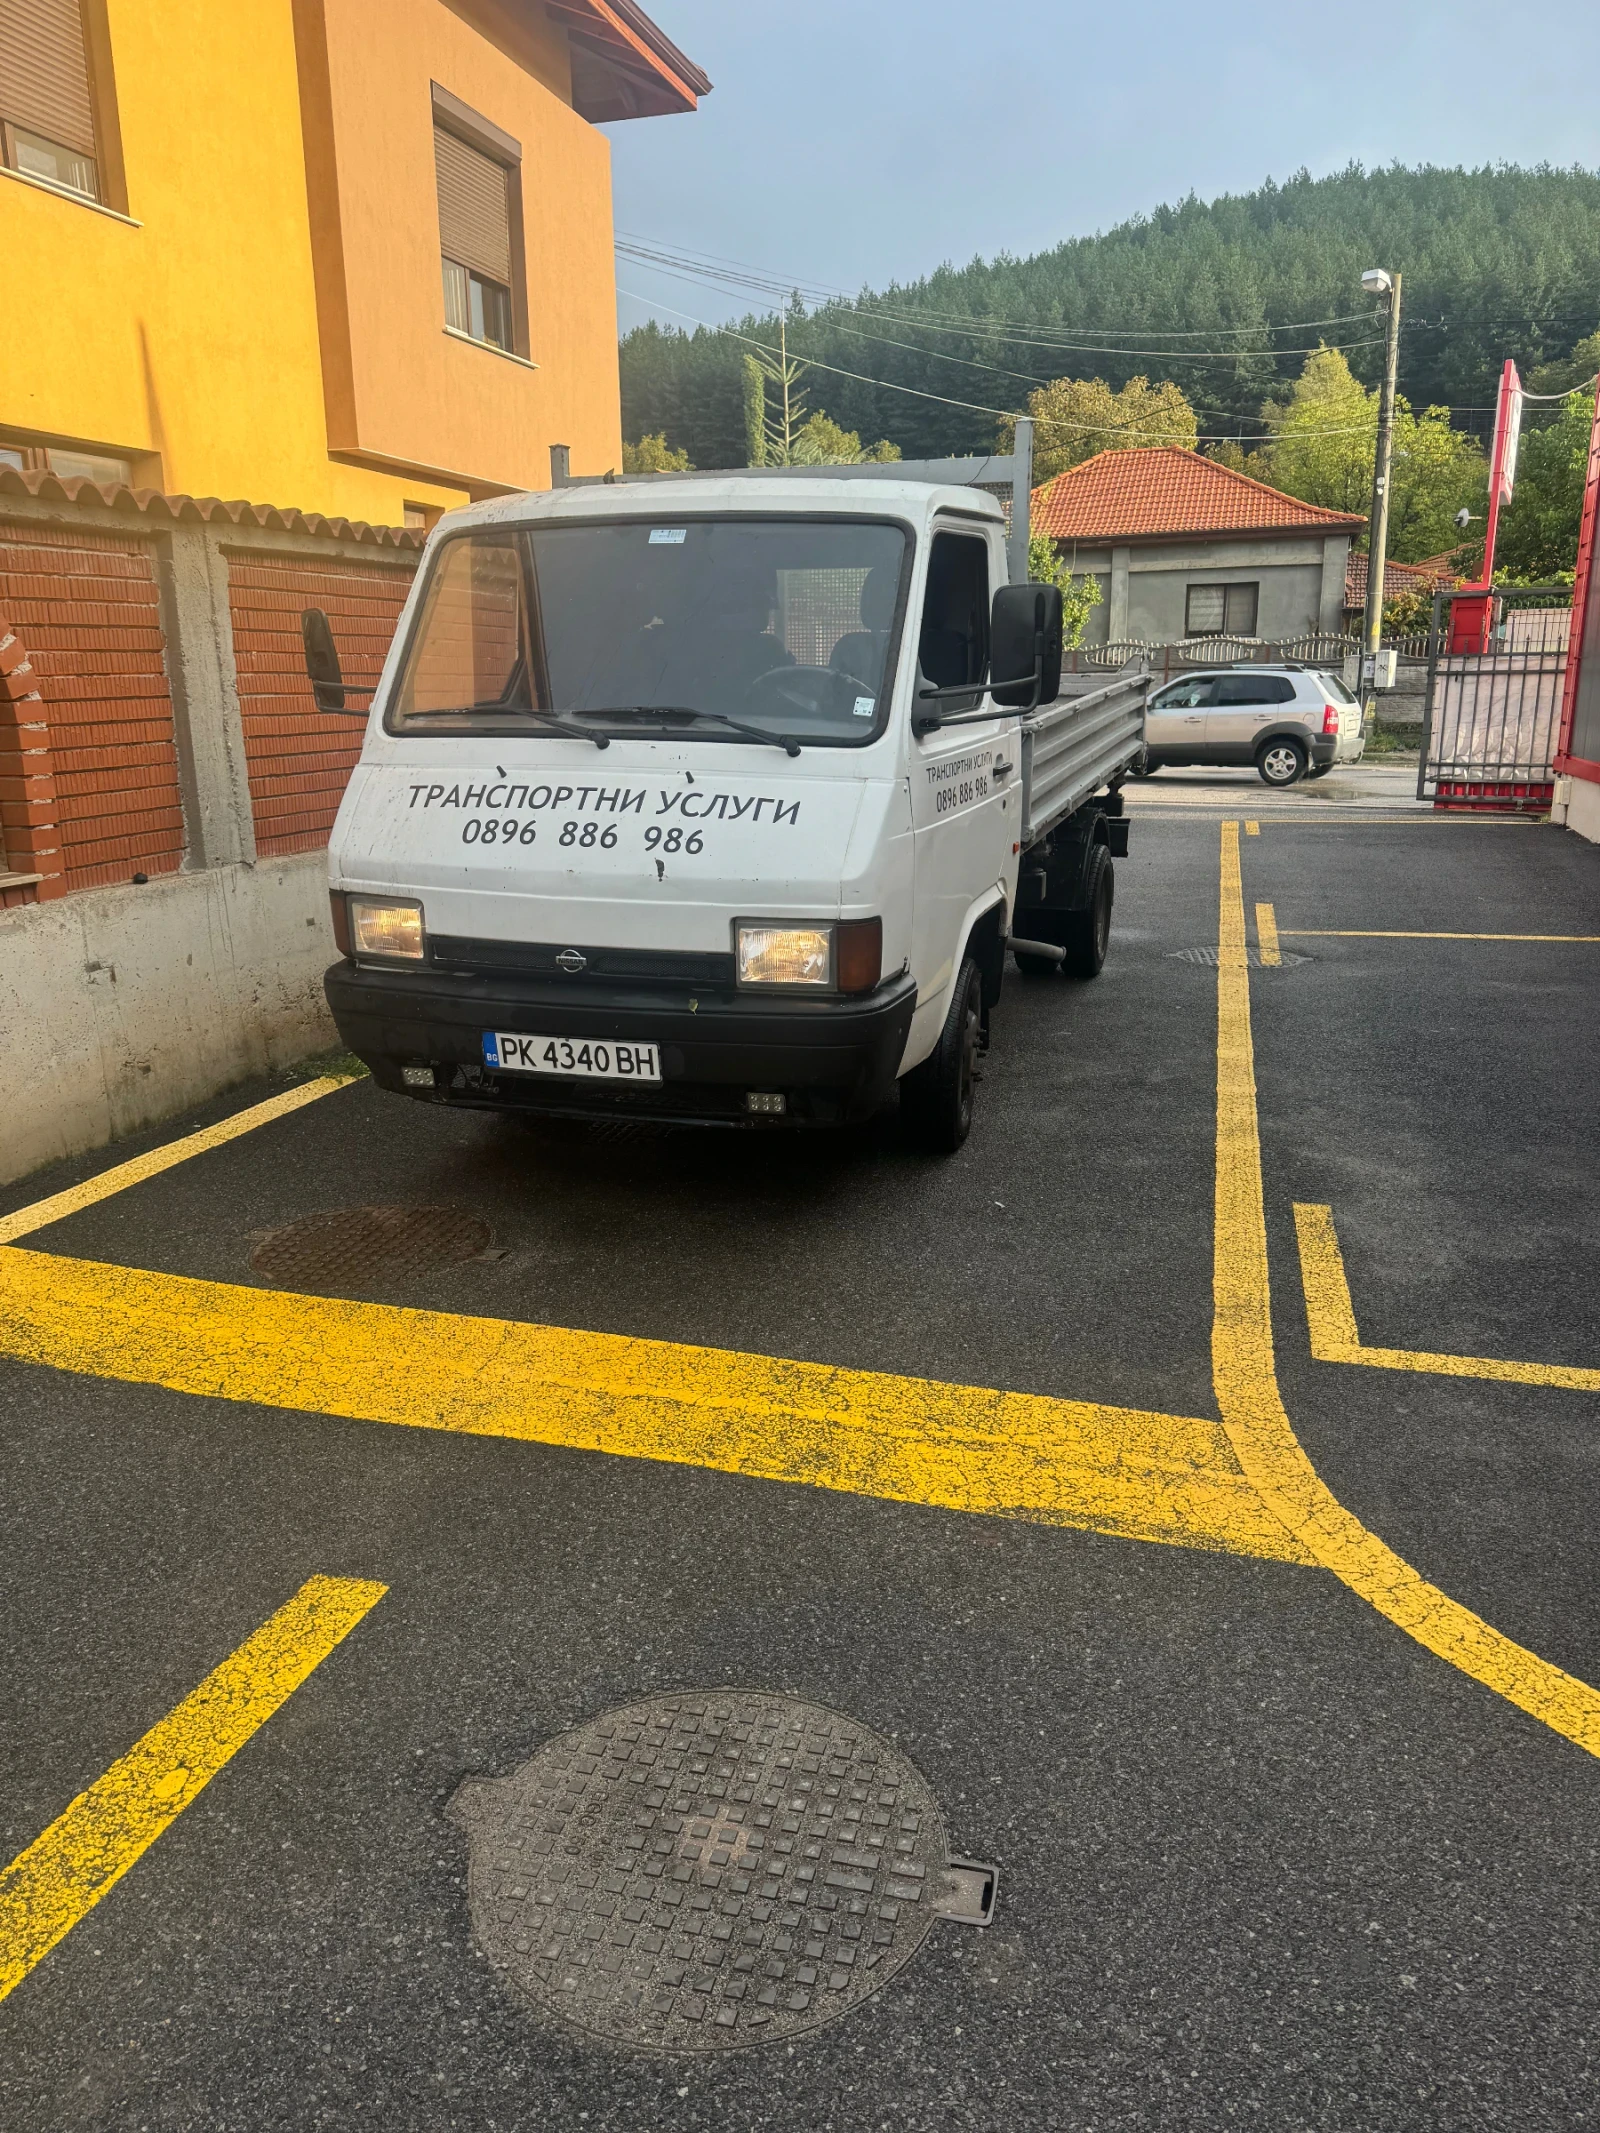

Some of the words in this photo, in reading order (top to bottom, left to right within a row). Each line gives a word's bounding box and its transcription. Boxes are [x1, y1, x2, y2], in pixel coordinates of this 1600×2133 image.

[926, 758, 972, 784] ТРАНСПОРТНИ
[408, 784, 647, 814] ТРАНСПОРТНИ
[655, 790, 801, 825] УСЛУГИ
[936, 786, 957, 813] 0896
[959, 781, 974, 804] 886
[975, 775, 988, 798] 986
[461, 818, 537, 845] 0896
[558, 821, 619, 849] 886
[643, 825, 704, 855] 986
[487, 1052, 498, 1062] BG
[543, 1041, 610, 1073] 4340
